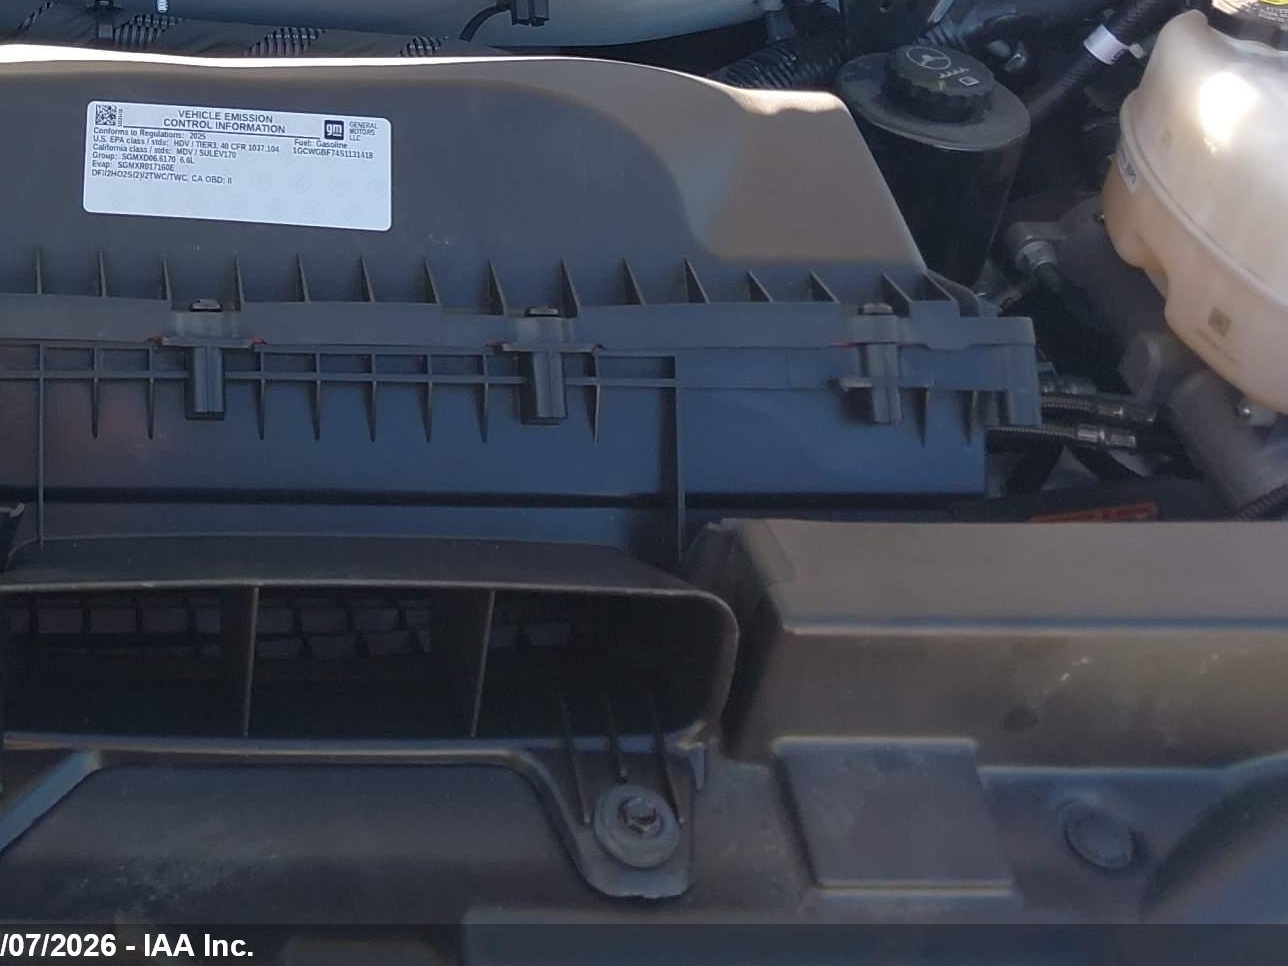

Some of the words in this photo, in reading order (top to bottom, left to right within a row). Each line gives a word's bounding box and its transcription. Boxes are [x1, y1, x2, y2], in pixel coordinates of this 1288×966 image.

[178, 110, 222, 121] VEHICLE
[224, 112, 273, 123] EMISSION
[163, 118, 213, 130] CONTROL
[215, 121, 286, 133] INFORMATION
[349, 121, 378, 129] GENERAL
[93, 127, 129, 135] Conforms
[139, 129, 184, 139] Regulations:
[189, 132, 207, 140] 2025
[349, 128, 376, 136] MOTORS
[93, 135, 106, 143] U.S.
[109, 136, 124, 144] EPA
[126, 137, 145, 145] class
[151, 138, 169, 146] stds:
[173, 140, 189, 148] HDV
[220, 142, 229, 150] 40
[230, 143, 246, 151] CFR
[248, 144, 280, 153] 1037.104
[294, 138, 312, 147] Fuel:
[315, 140, 348, 149] Gasoline
[92, 143, 127, 152] California
[129, 145, 147, 153] class
[199, 149, 237, 158] SULEV170
[92, 151, 117, 160] Group:
[92, 159, 113, 168] Evap:
[191, 174, 203, 182] CA
[205, 175, 225, 184] OBD:
